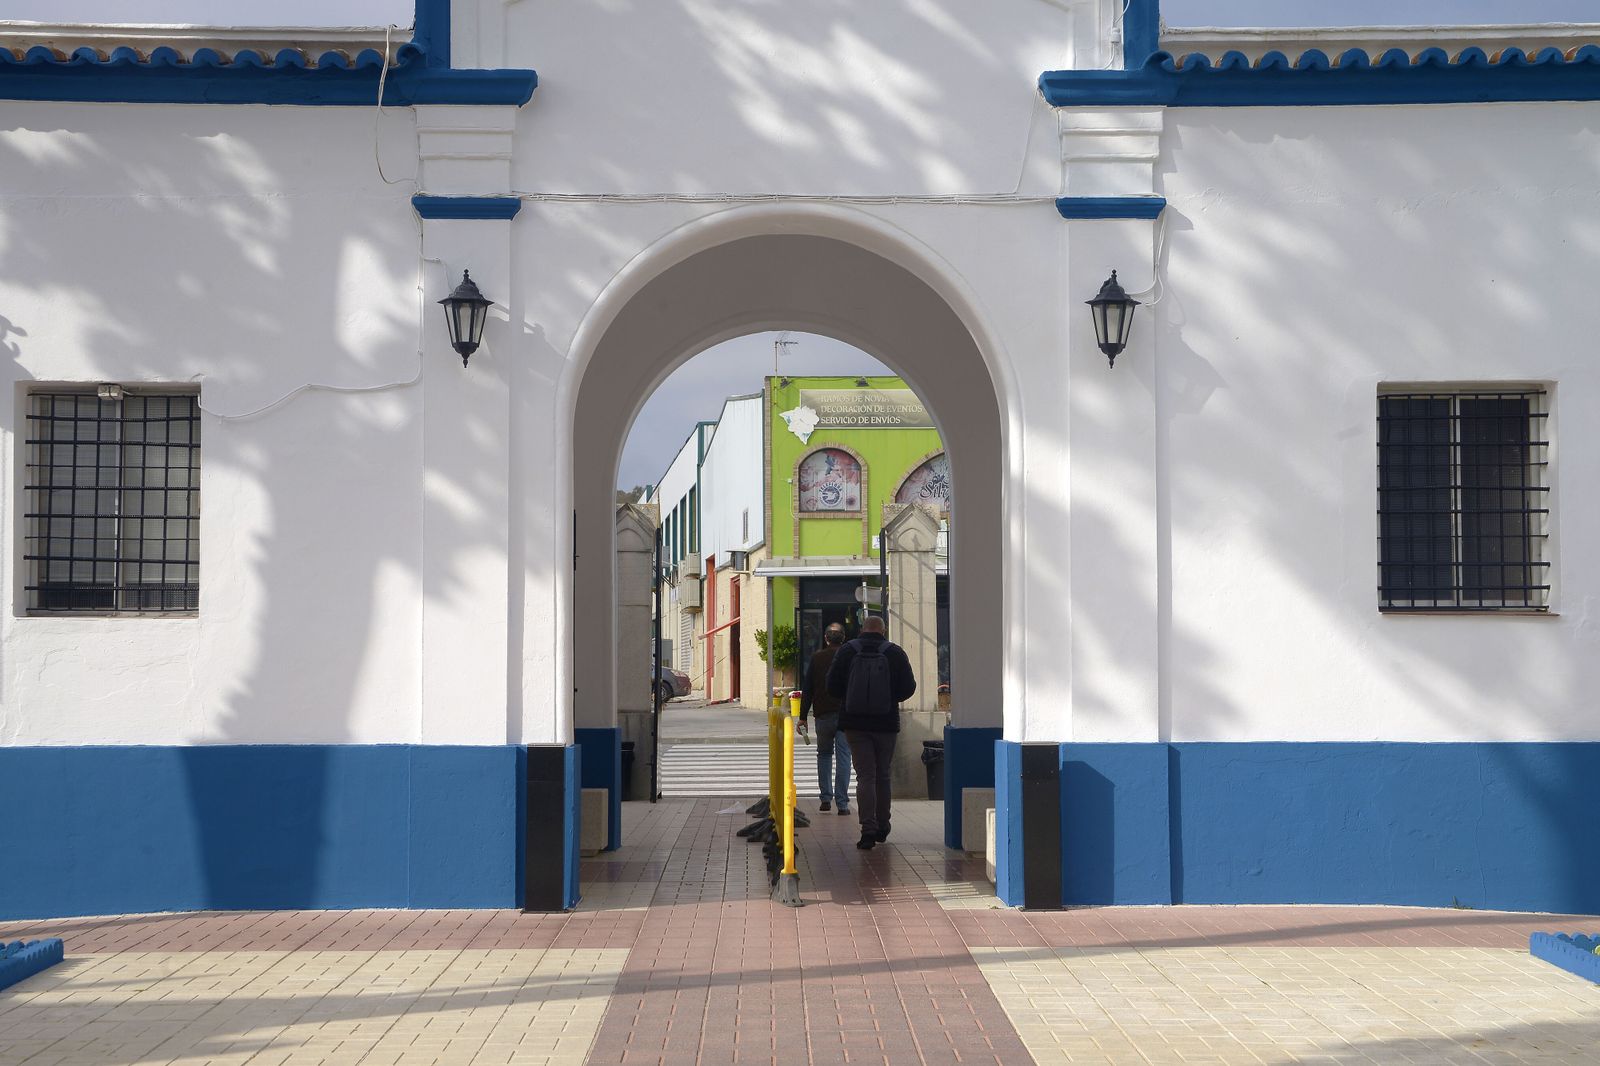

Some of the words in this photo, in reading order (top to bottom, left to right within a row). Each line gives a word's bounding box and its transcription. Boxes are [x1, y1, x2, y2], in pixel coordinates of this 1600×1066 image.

[852, 395, 863, 403] DE
[821, 403, 873, 413] DECORACIÓN
[874, 405, 886, 413] DE
[886, 404, 923, 413] EVENTOS
[821, 416, 856, 424] SERVICIO
[858, 416, 870, 424] DE
[871, 415, 901, 424] ENVÍOS
